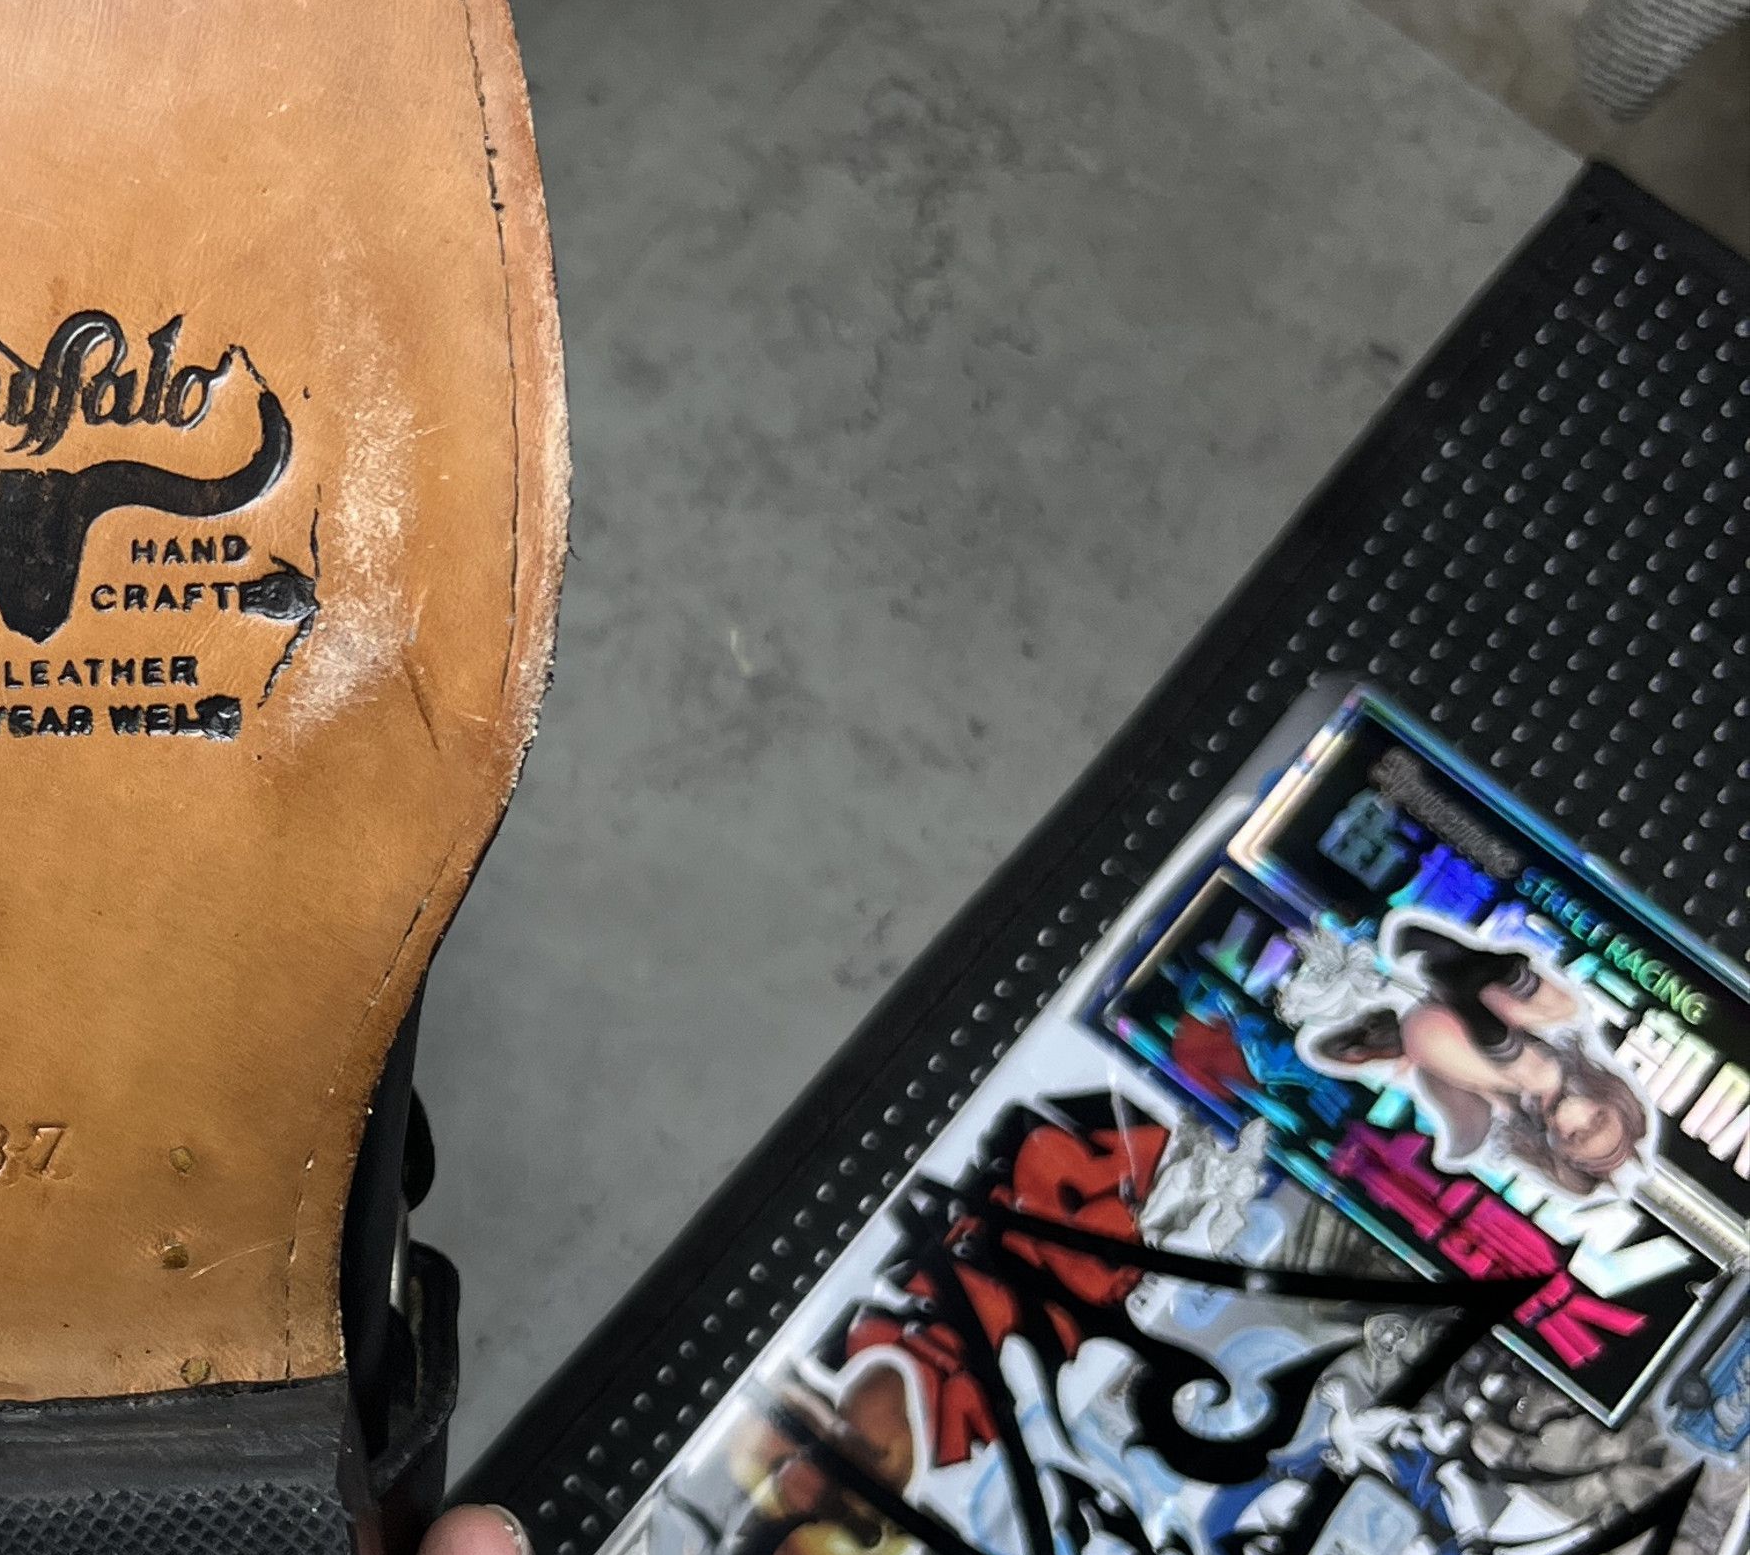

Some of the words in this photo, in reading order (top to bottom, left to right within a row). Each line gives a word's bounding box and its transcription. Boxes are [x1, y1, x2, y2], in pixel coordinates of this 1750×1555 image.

[130, 534, 251, 566] HAND
[4, 656, 199, 688] LEATHER
[109, 695, 242, 742] WEL
[1513, 862, 1615, 952] STREET
[1602, 930, 1713, 1027] RACING
